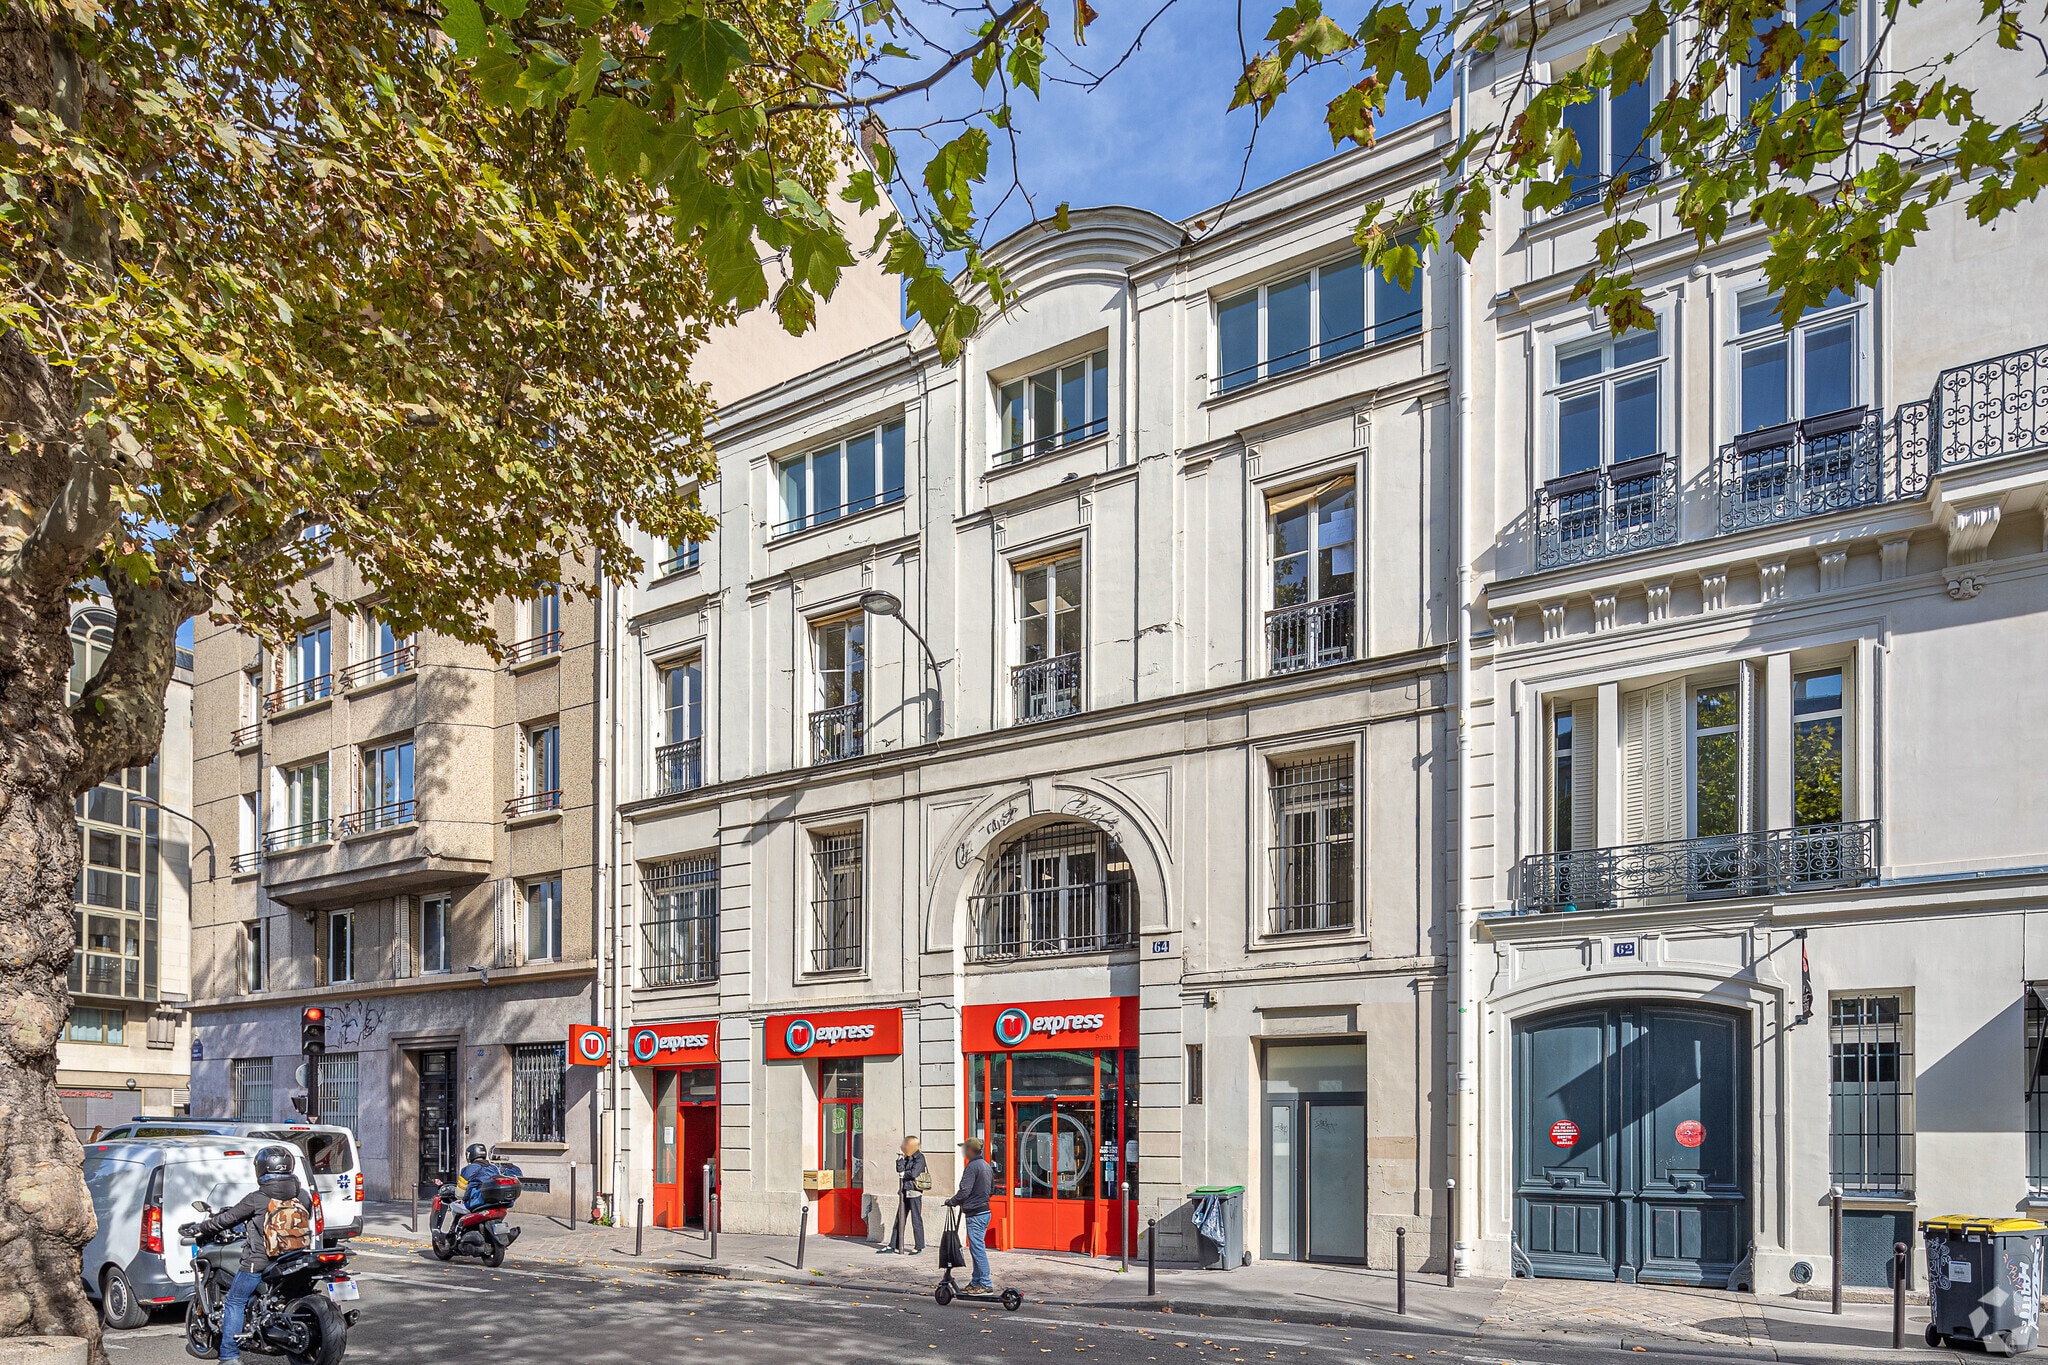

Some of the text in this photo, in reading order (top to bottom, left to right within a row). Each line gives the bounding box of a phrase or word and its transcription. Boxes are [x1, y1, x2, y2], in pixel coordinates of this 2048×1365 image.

[1154, 941, 1168, 952] 64
[1616, 943, 1633, 954] 62
[1032, 1013, 1105, 1035] express
[816, 1024, 875, 1044] express
[1095, 1033, 1112, 1042] Paris
[659, 1034, 710, 1052] express
